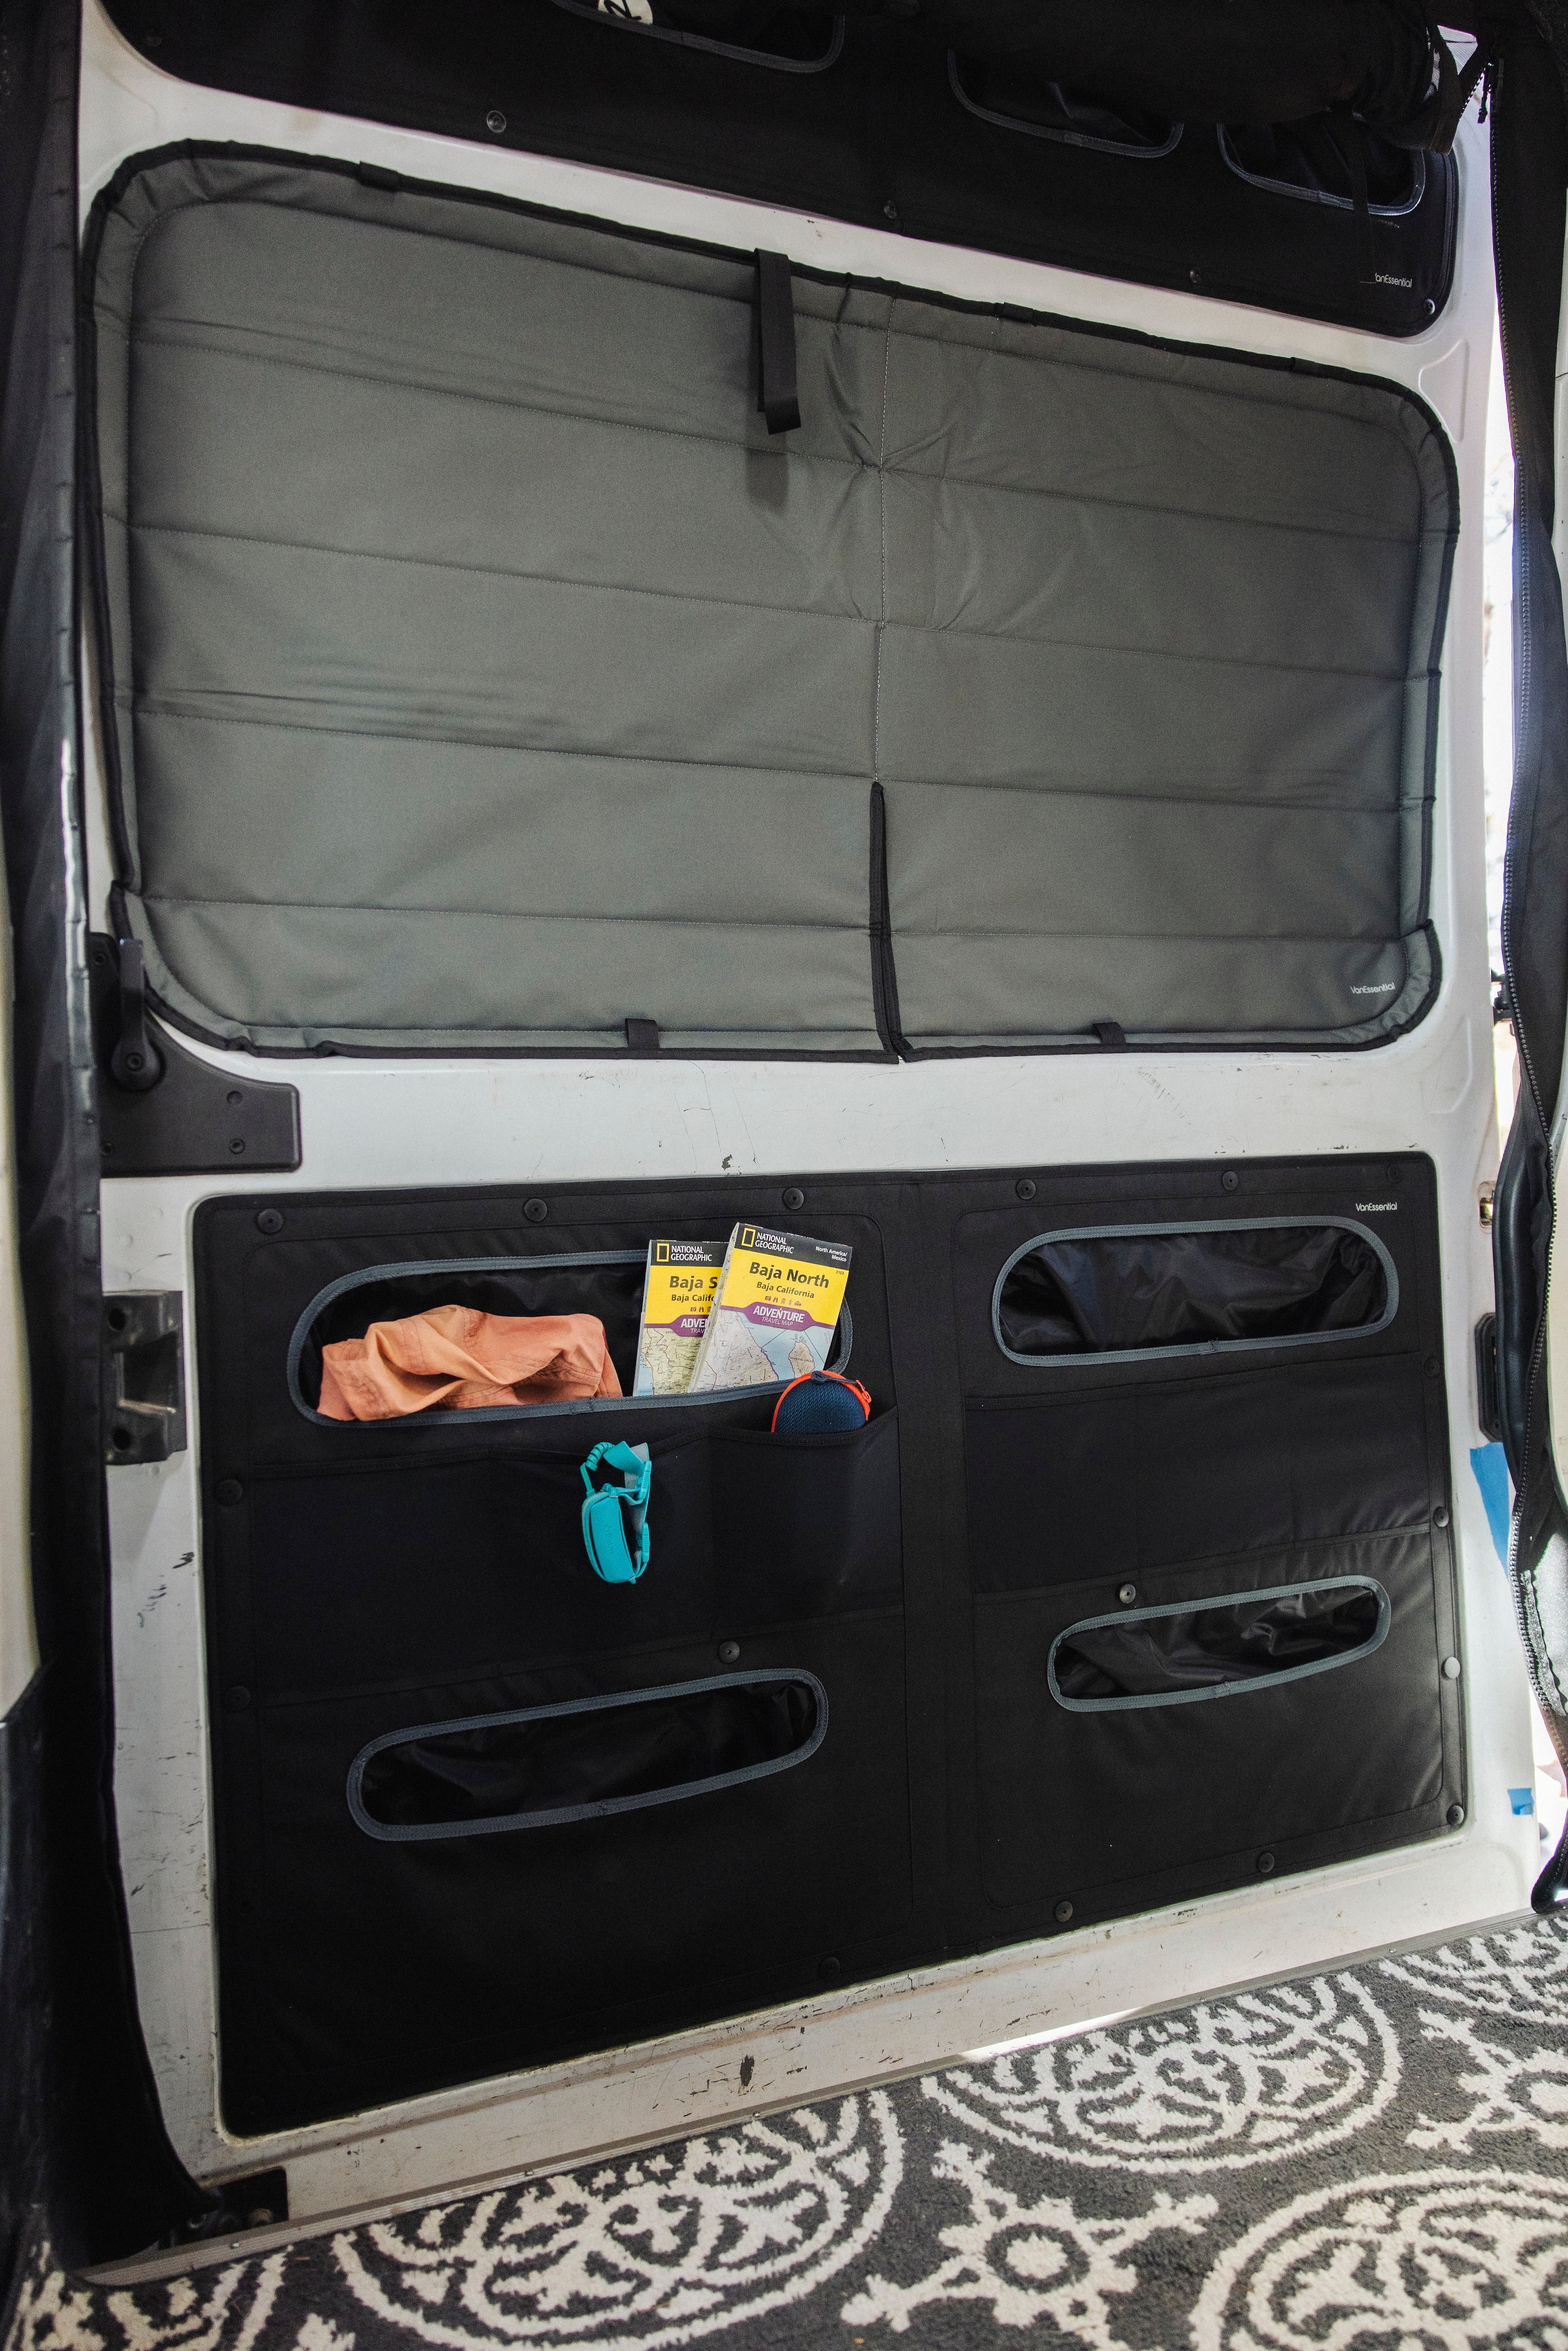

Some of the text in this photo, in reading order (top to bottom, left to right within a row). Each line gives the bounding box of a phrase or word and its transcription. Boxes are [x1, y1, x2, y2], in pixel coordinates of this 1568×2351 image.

[1350, 982, 1396, 994] VanEssential
[1355, 1201, 1398, 1212] VanEssential
[757, 1232, 787, 1245] NATIONAL
[671, 1245, 704, 1254] NATIONAL
[755, 1240, 794, 1254] GEOGRAPHIC
[671, 1253, 712, 1261] GEOGRAPHIC
[749, 1261, 829, 1288] Baja North
[669, 1275, 703, 1292] Baja
[757, 1282, 815, 1298] Baja California
[671, 1294, 689, 1303] Baja
[753, 1305, 805, 1323] ADVENTURE
[762, 1316, 781, 1325] TRAVEL
